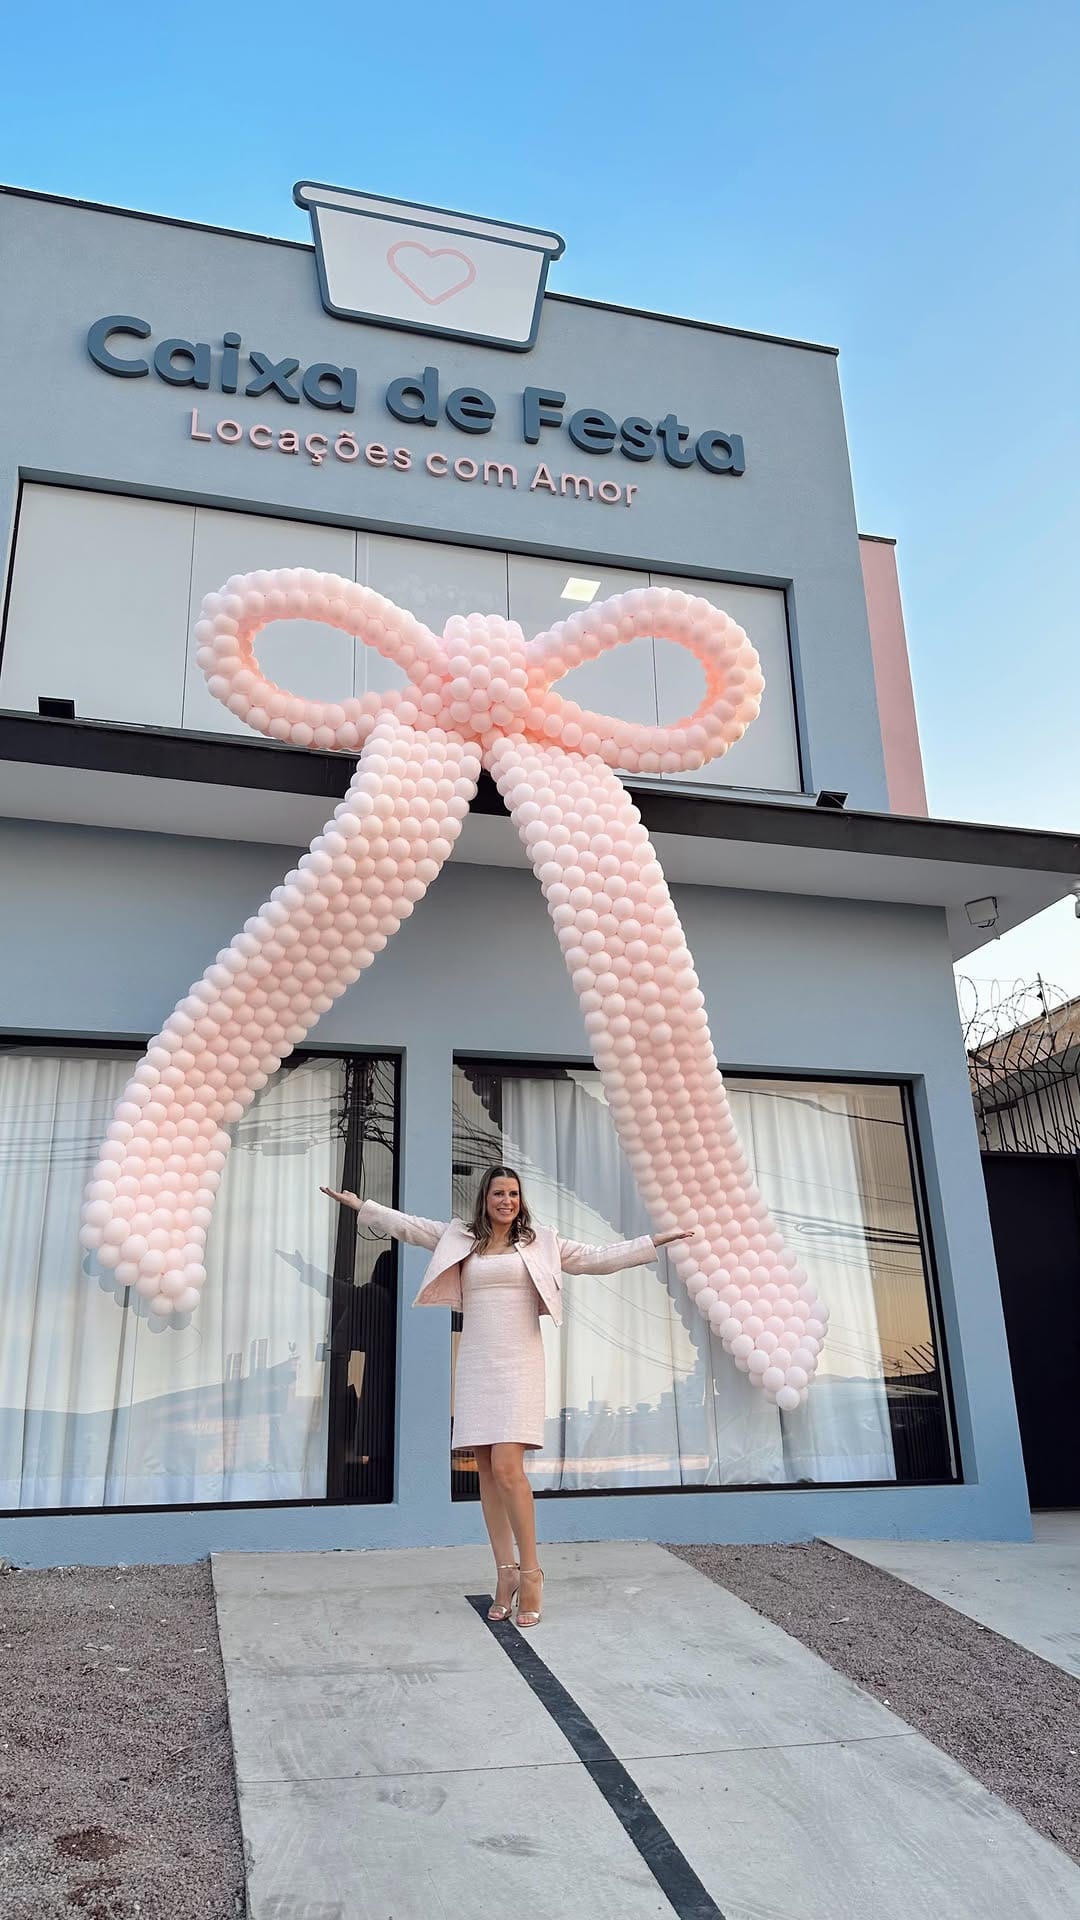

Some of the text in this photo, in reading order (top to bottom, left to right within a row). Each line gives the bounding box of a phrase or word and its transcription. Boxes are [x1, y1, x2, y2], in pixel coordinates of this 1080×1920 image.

[87, 315, 746, 476] Caixa de Festa
[190, 408, 639, 507] Locações com Amor
